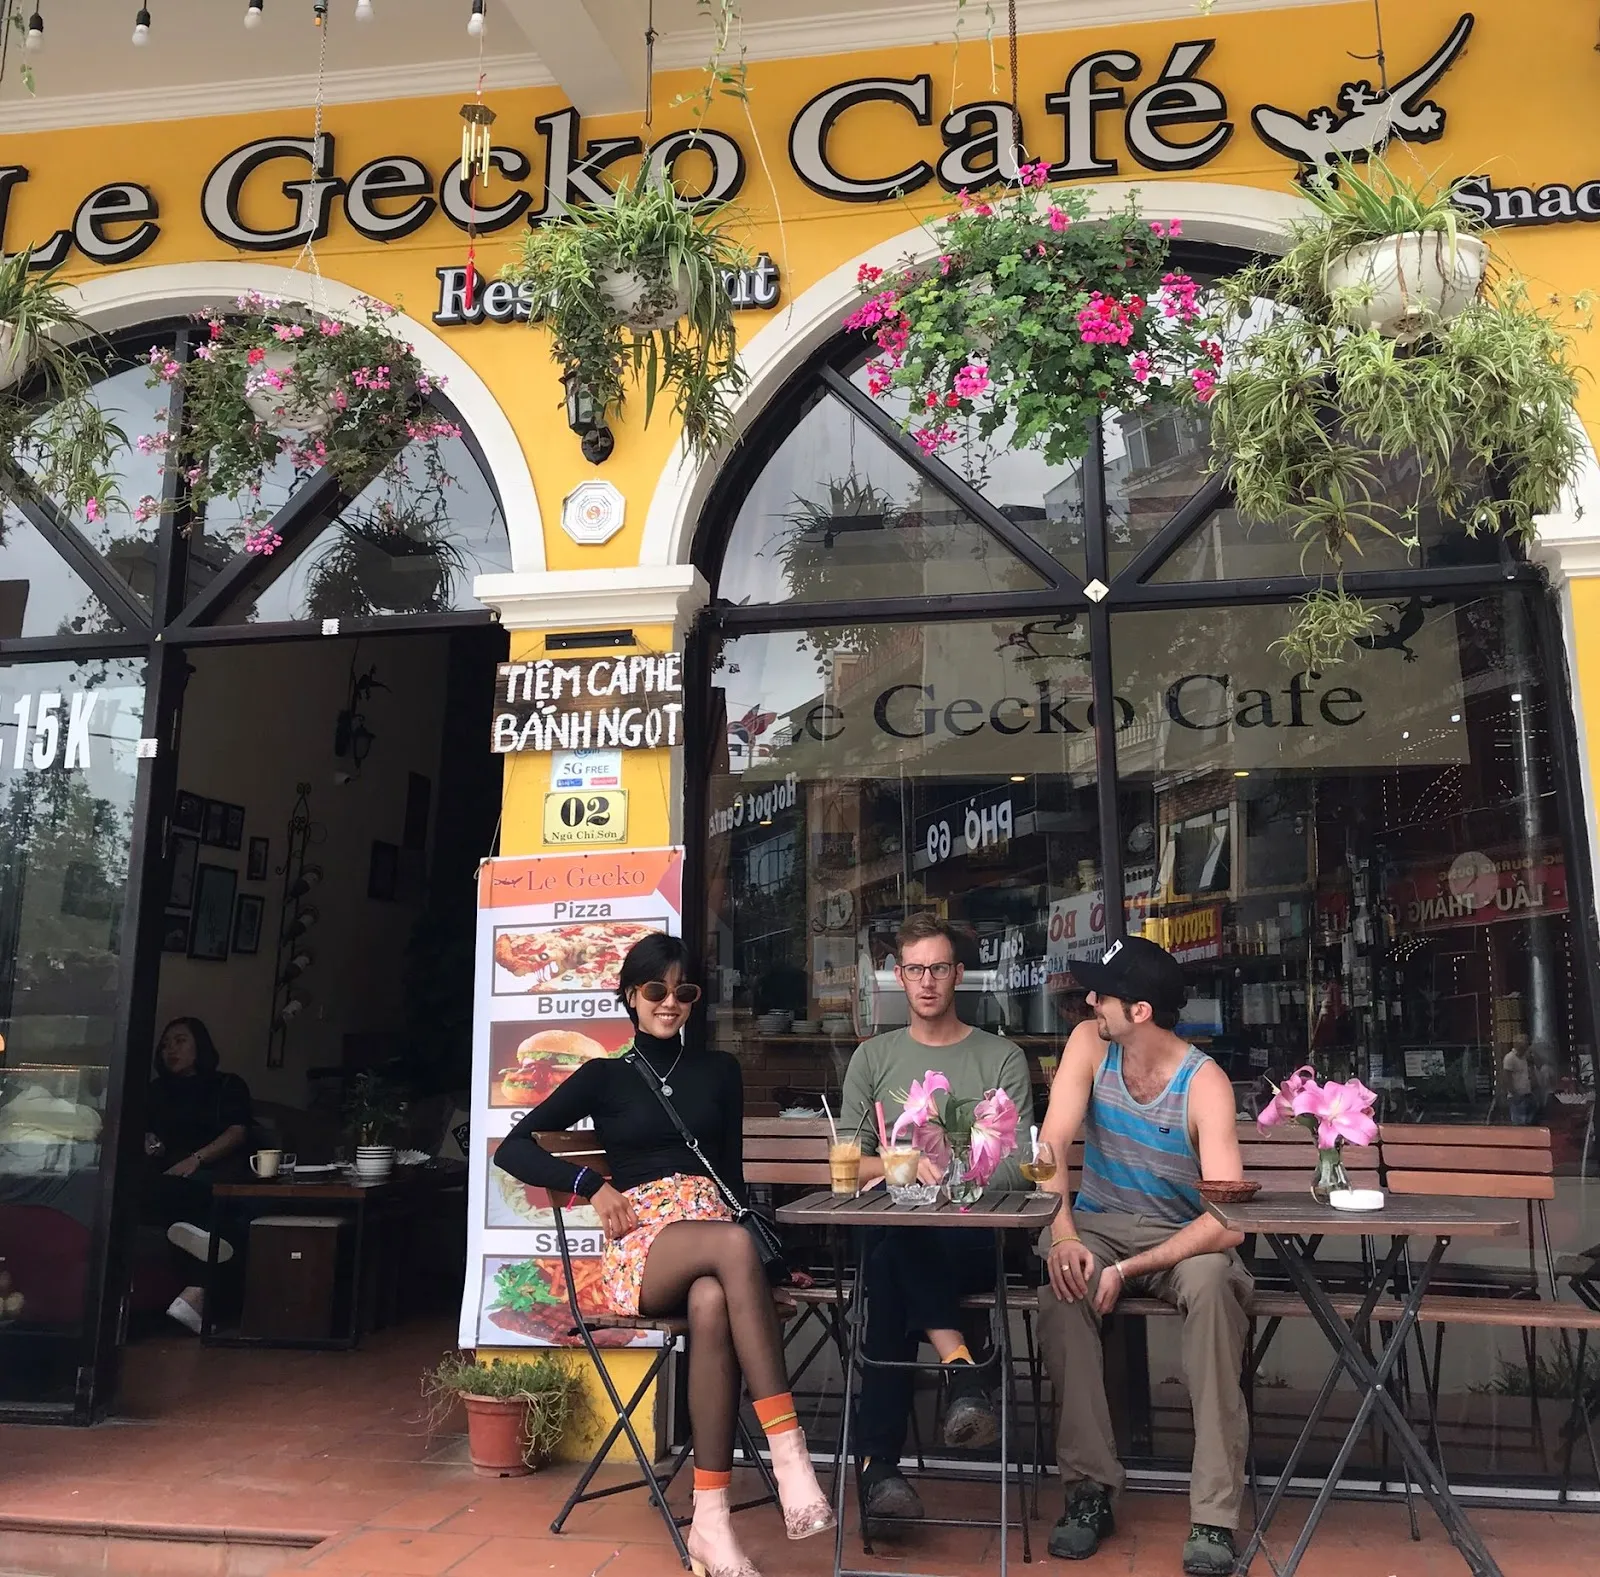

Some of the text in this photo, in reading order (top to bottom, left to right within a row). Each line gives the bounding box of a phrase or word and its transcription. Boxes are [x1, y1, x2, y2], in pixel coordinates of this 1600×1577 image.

[0, 38, 1232, 271] Le Gecko Café
[873, 680, 1135, 738] Gecko
[1165, 671, 1366, 730] Cafe
[13, 691, 99, 770] 15K
[492, 705, 592, 752] BÁNH
[563, 761, 609, 775] 5G FREE
[560, 796, 611, 827] 02
[527, 864, 646, 891] Le Gecko
[553, 901, 612, 919] Pizza
[538, 996, 621, 1017] Burger
